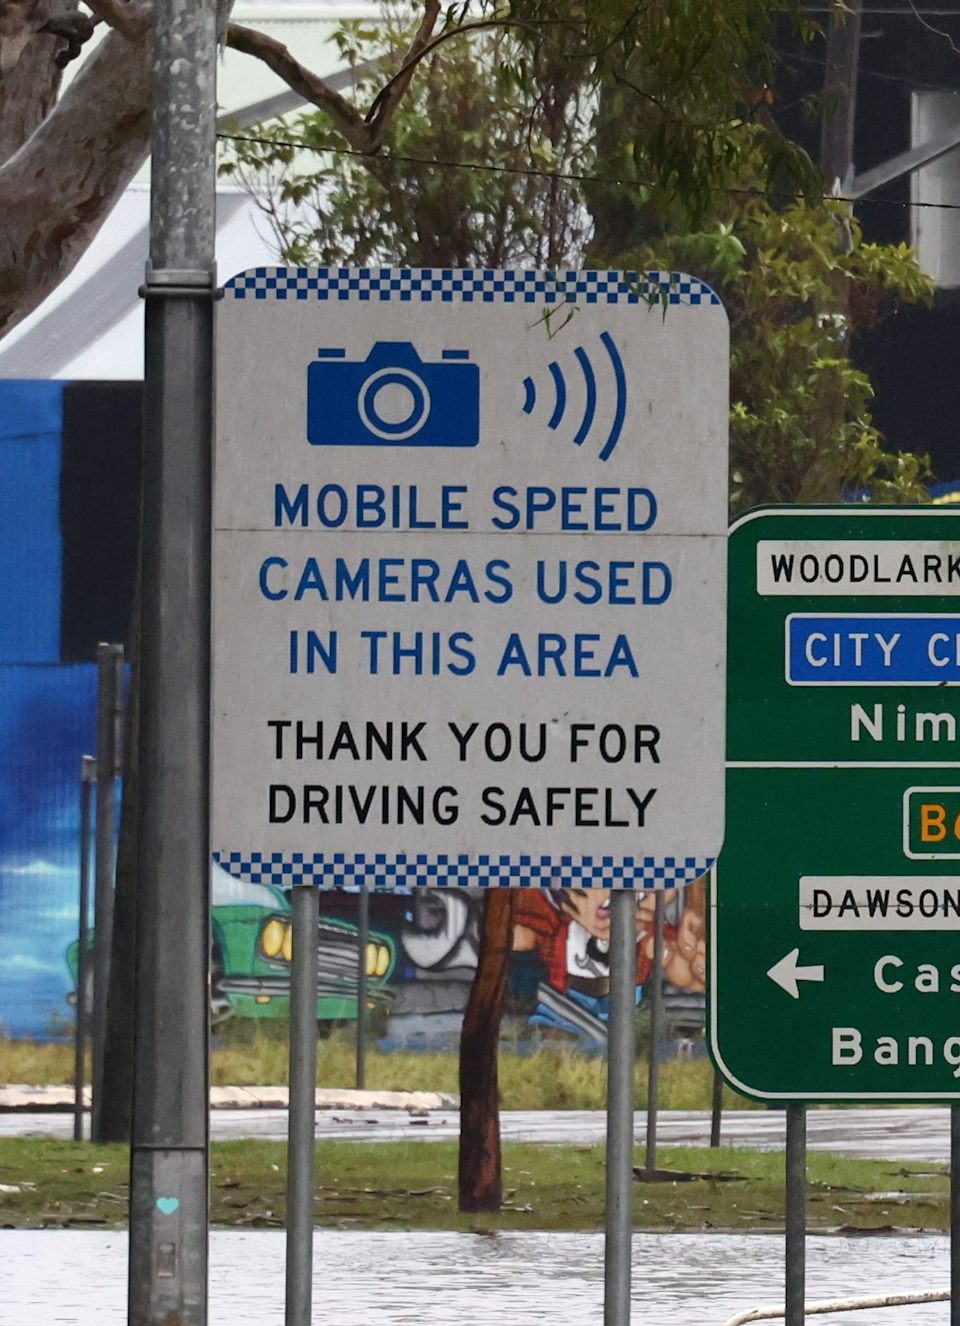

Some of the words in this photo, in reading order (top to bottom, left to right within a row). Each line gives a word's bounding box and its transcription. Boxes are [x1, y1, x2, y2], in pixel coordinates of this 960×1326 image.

[275, 484, 468, 529] MOBILE
[492, 486, 657, 531] SPEED
[259, 557, 512, 603] CAMERAS
[537, 561, 672, 605] USED
[290, 631, 337, 674] IN
[361, 631, 475, 675] THIS
[497, 633, 639, 677] AREA
[806, 633, 900, 666] CITY
[268, 721, 427, 761] THANK
[448, 722, 546, 762] YOU
[571, 724, 660, 763] FOR
[269, 785, 458, 825] DRIVING
[481, 787, 657, 827] SAFELY
